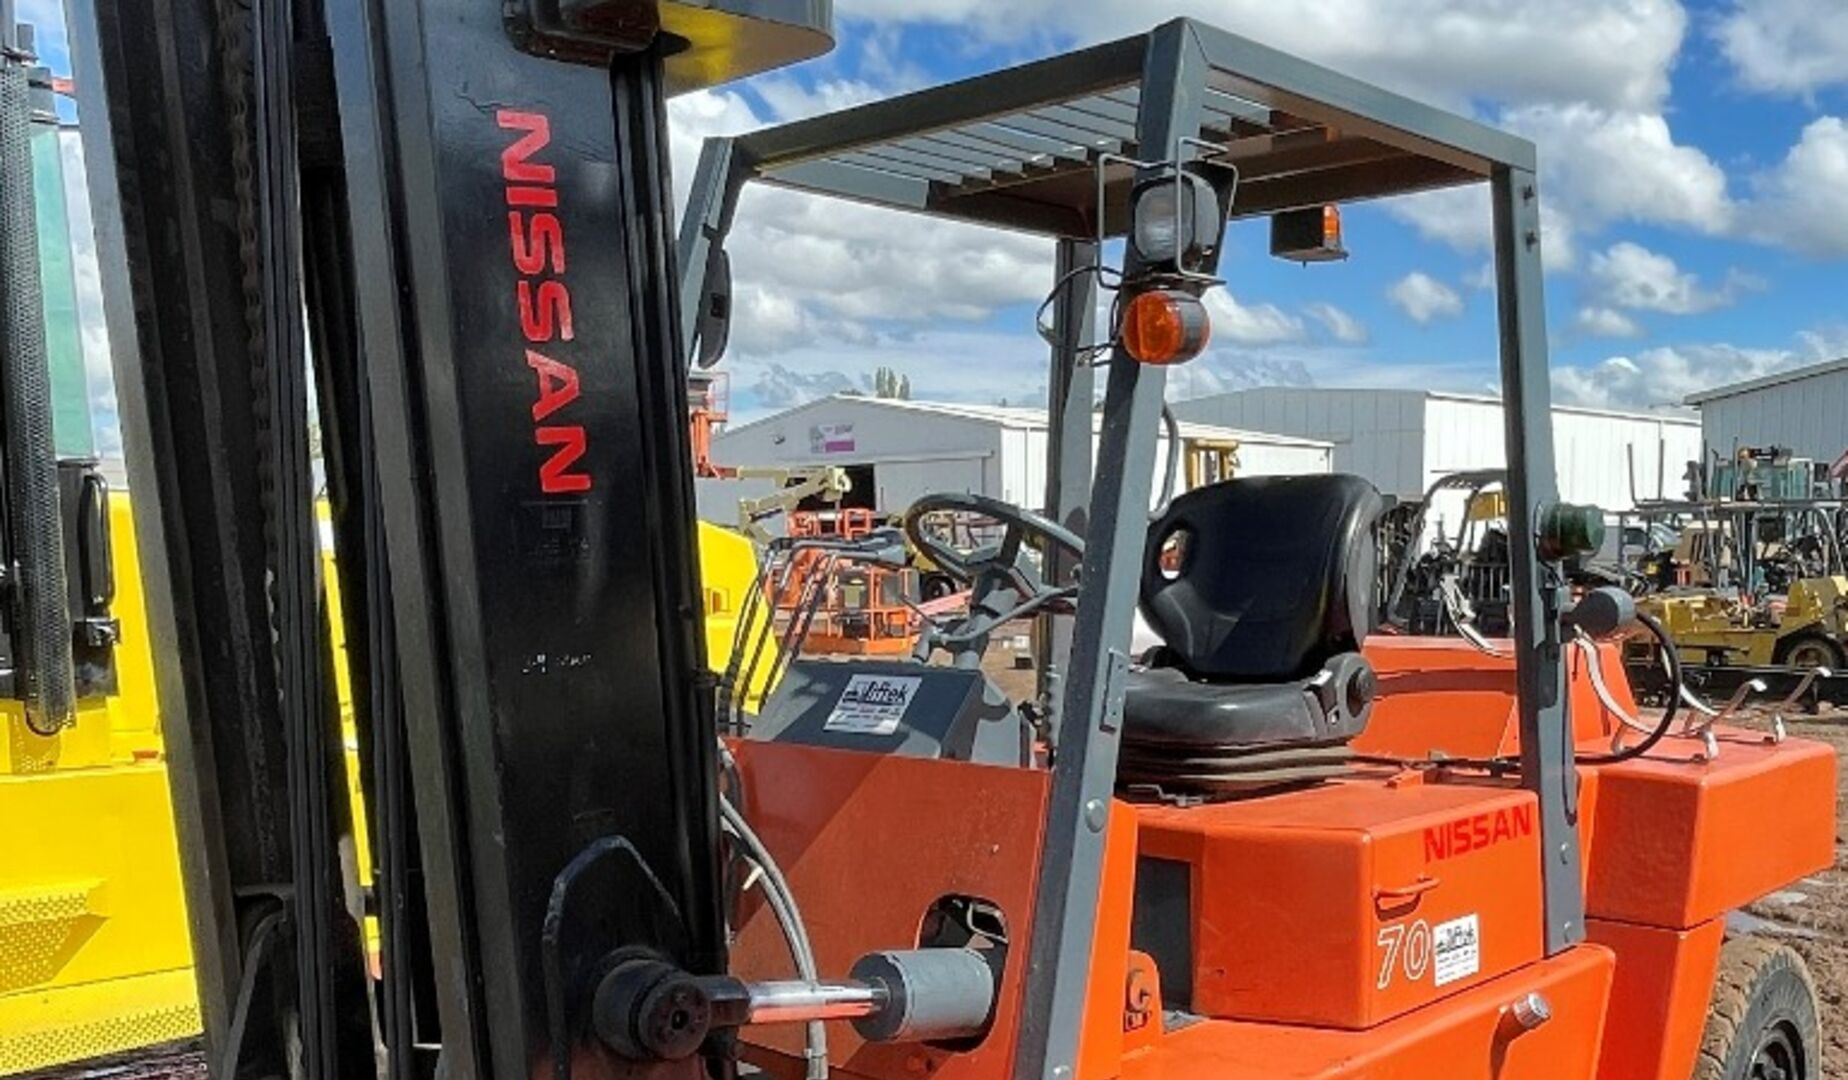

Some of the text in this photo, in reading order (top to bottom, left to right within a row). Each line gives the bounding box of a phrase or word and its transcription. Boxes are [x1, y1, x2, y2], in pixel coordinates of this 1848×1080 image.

[496, 109, 591, 493] NISSAN
[1423, 803, 1533, 864] NISSAN
[1377, 919, 1431, 989] 70
